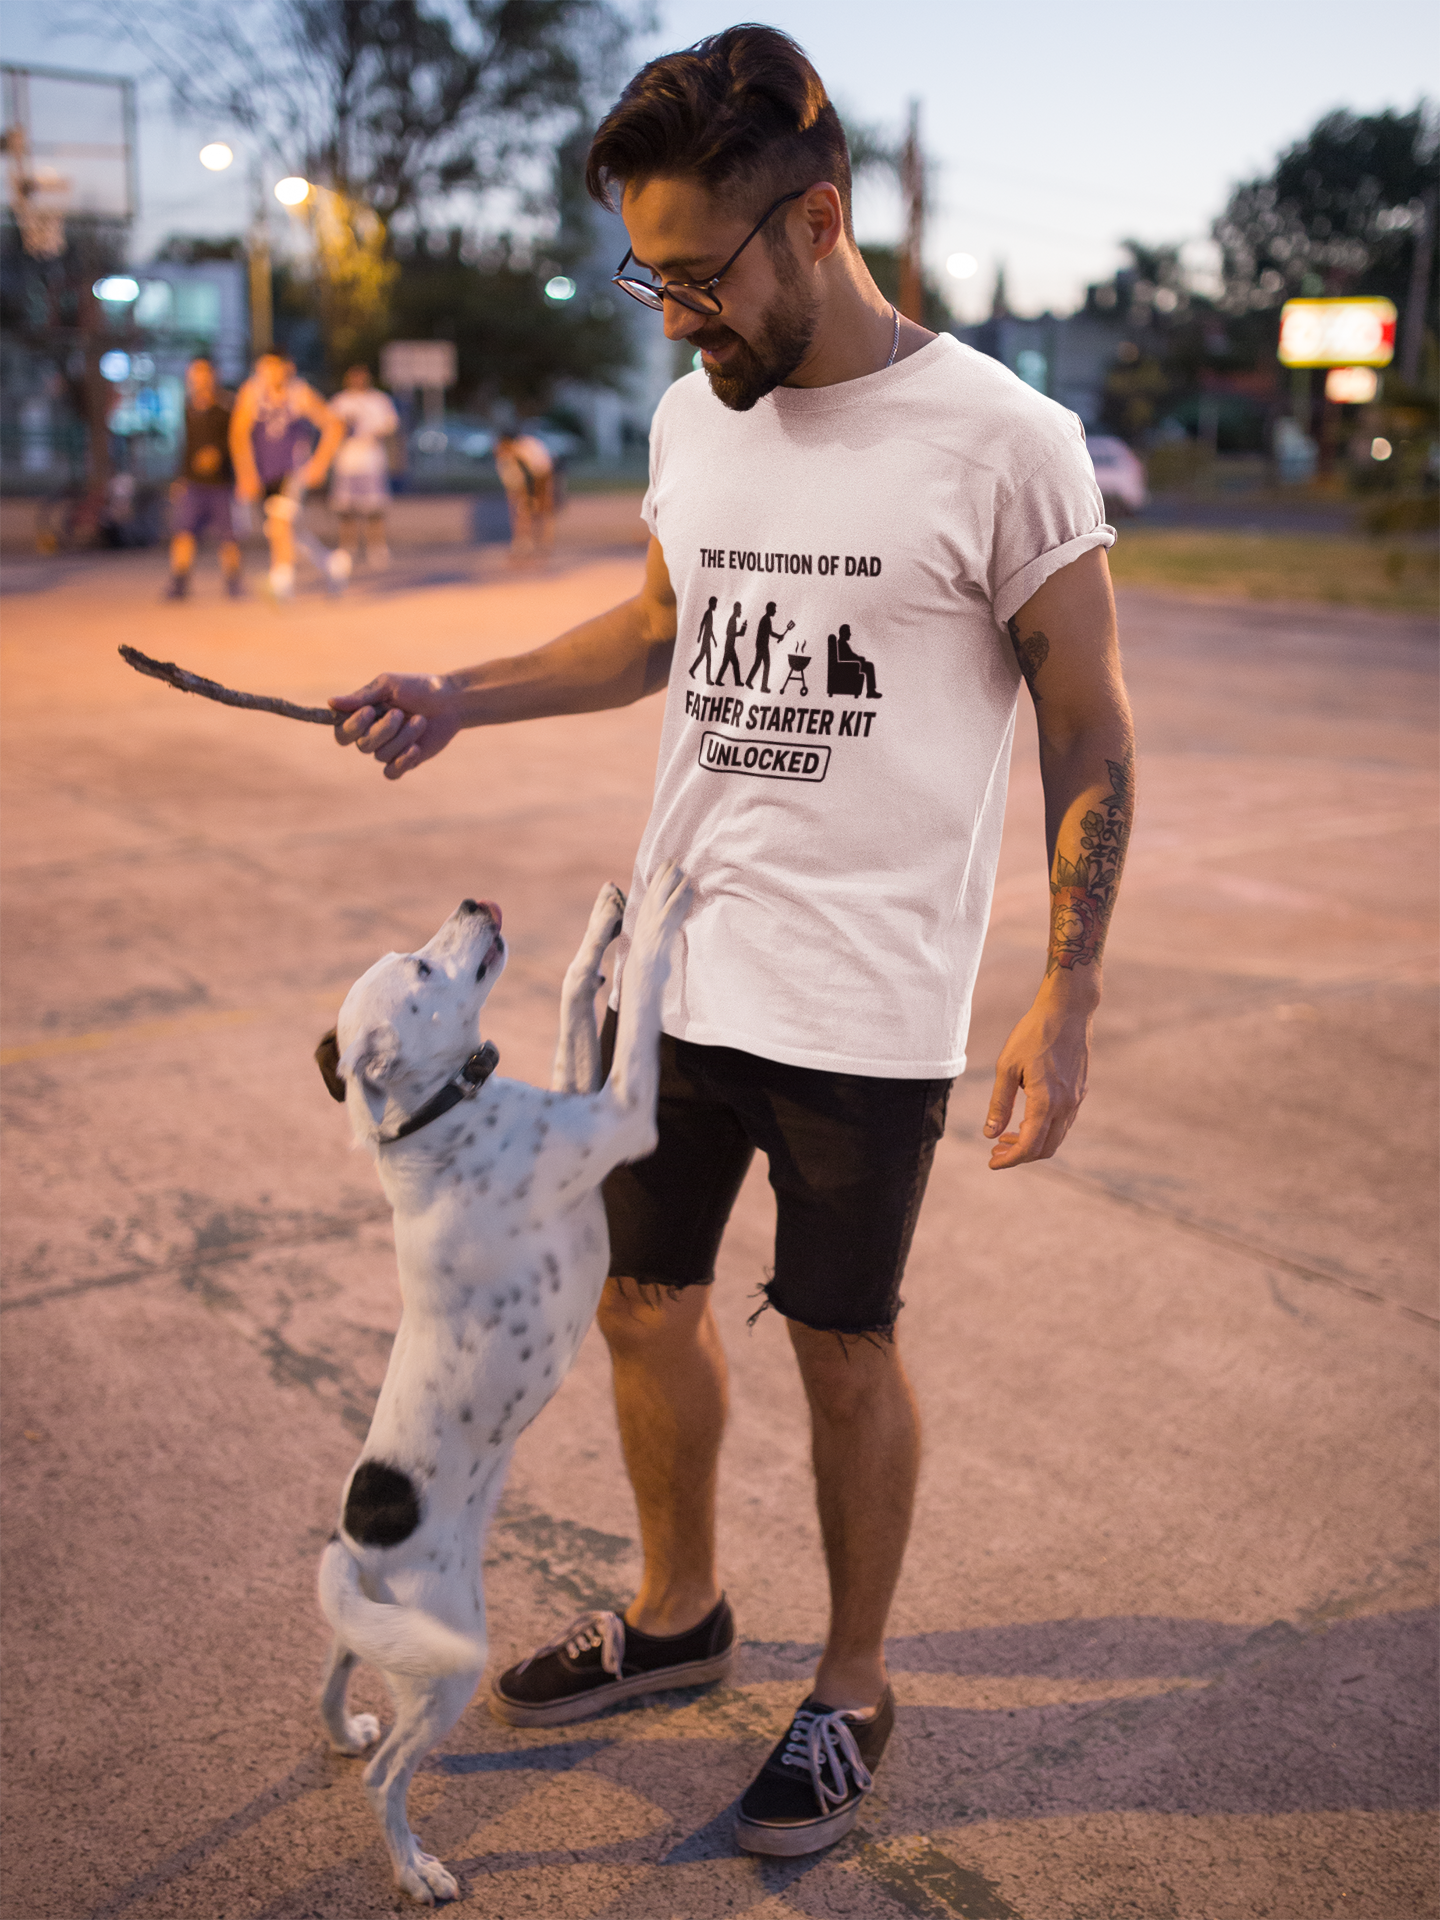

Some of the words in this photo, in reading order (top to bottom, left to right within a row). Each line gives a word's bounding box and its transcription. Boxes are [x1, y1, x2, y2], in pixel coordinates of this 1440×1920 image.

[699, 548, 725, 569] THE
[729, 550, 813, 575] EVOLUTION
[817, 555, 840, 576] OF
[844, 556, 882, 577] DAD
[685, 690, 744, 728] FATHER
[745, 704, 835, 736] STARTER
[837, 710, 877, 738] KIT
[706, 738, 820, 775] UNLOCKED
